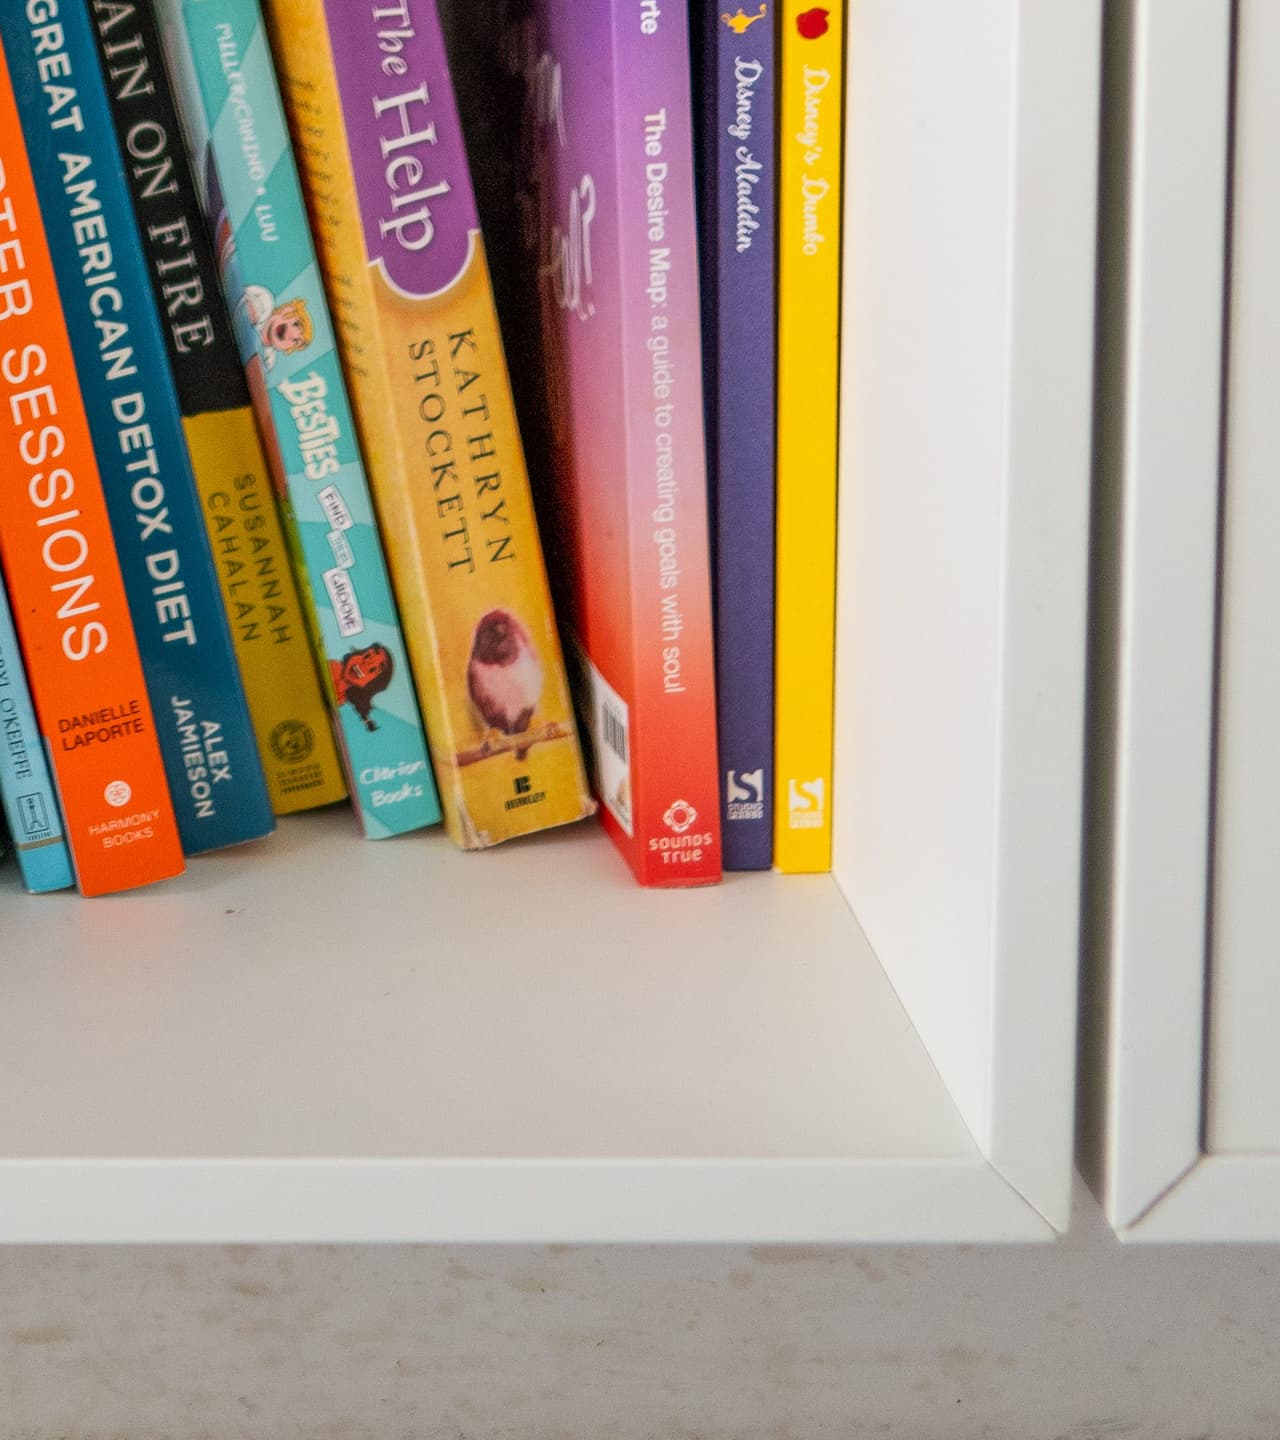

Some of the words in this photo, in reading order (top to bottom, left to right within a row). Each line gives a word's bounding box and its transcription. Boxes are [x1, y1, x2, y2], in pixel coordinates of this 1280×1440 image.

[127, 121, 179, 199] ON
[373, 81, 450, 252] Help
[642, 109, 666, 160] The
[642, 163, 669, 243] Desire
[735, 146, 763, 253] Aladdin
[801, 173, 829, 256] Dumbo
[147, 221, 216, 354] FIRE
[646, 248, 669, 305] Map:
[58, 152, 138, 381] AMERICAN
[111, 392, 173, 541] DETOX
[147, 548, 197, 646] DIET
[276, 370, 340, 482] BESTIES
[448, 328, 515, 563] KATHRYN
[1, 344, 108, 662] SESSIONS
[408, 339, 475, 574] STOCKETT
[57, 699, 140, 733] DANIELLE
[62, 718, 145, 751] LAPORTE
